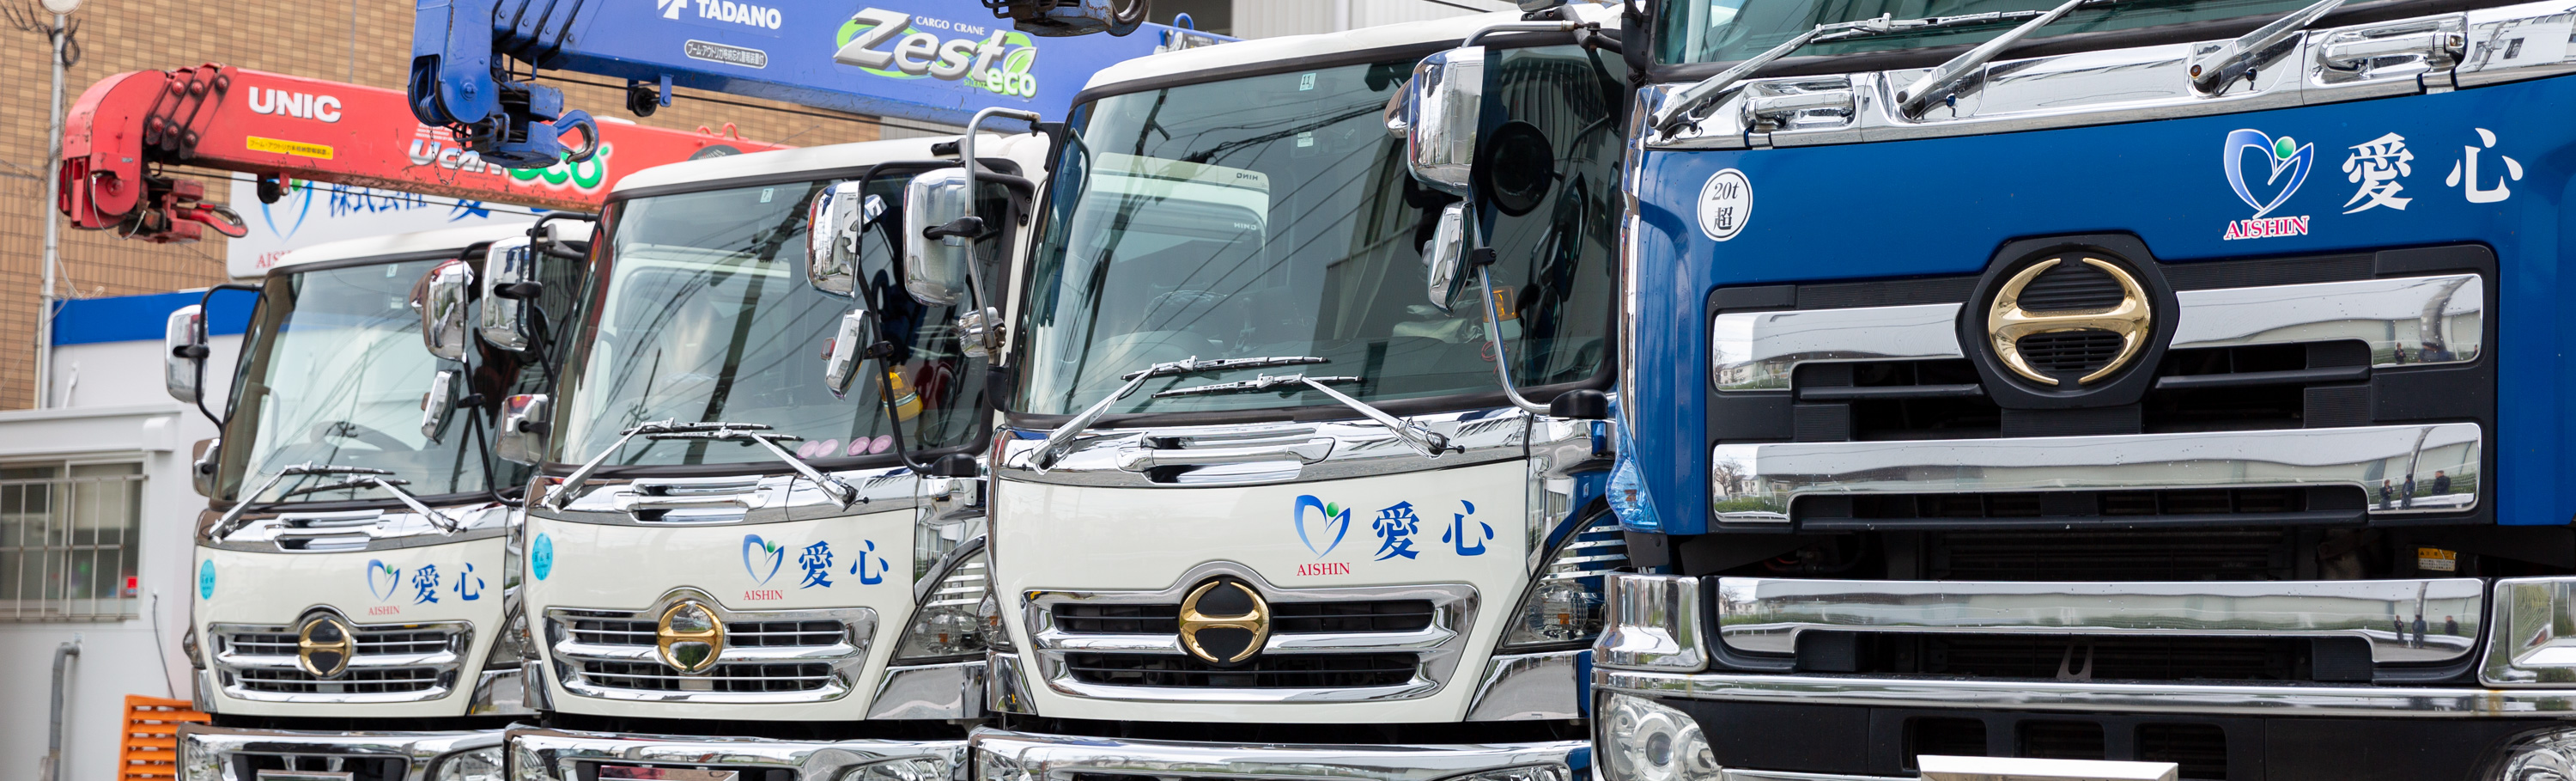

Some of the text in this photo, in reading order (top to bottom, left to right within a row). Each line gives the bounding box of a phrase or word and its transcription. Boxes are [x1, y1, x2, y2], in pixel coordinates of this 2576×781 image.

[696, 0, 781, 30] TADANO
[915, 15, 985, 36] CARGO CRANE
[833, 7, 1006, 81] Zest
[987, 67, 1037, 97] eco
[248, 86, 342, 123] UNIC
[2342, 128, 2524, 215] 愛心
[1712, 181, 1740, 200] 20t
[1233, 222, 1257, 231] HINO
[1713, 206, 1733, 231] 超
[2224, 216, 2310, 241] AISHIN
[1372, 500, 1494, 561] 愛心
[799, 540, 889, 589] 愛心
[1297, 563, 1351, 577] AISHIN
[412, 562, 485, 605] 愛心
[744, 589, 783, 601] AISHIN
[368, 605, 400, 616] AISHIN
